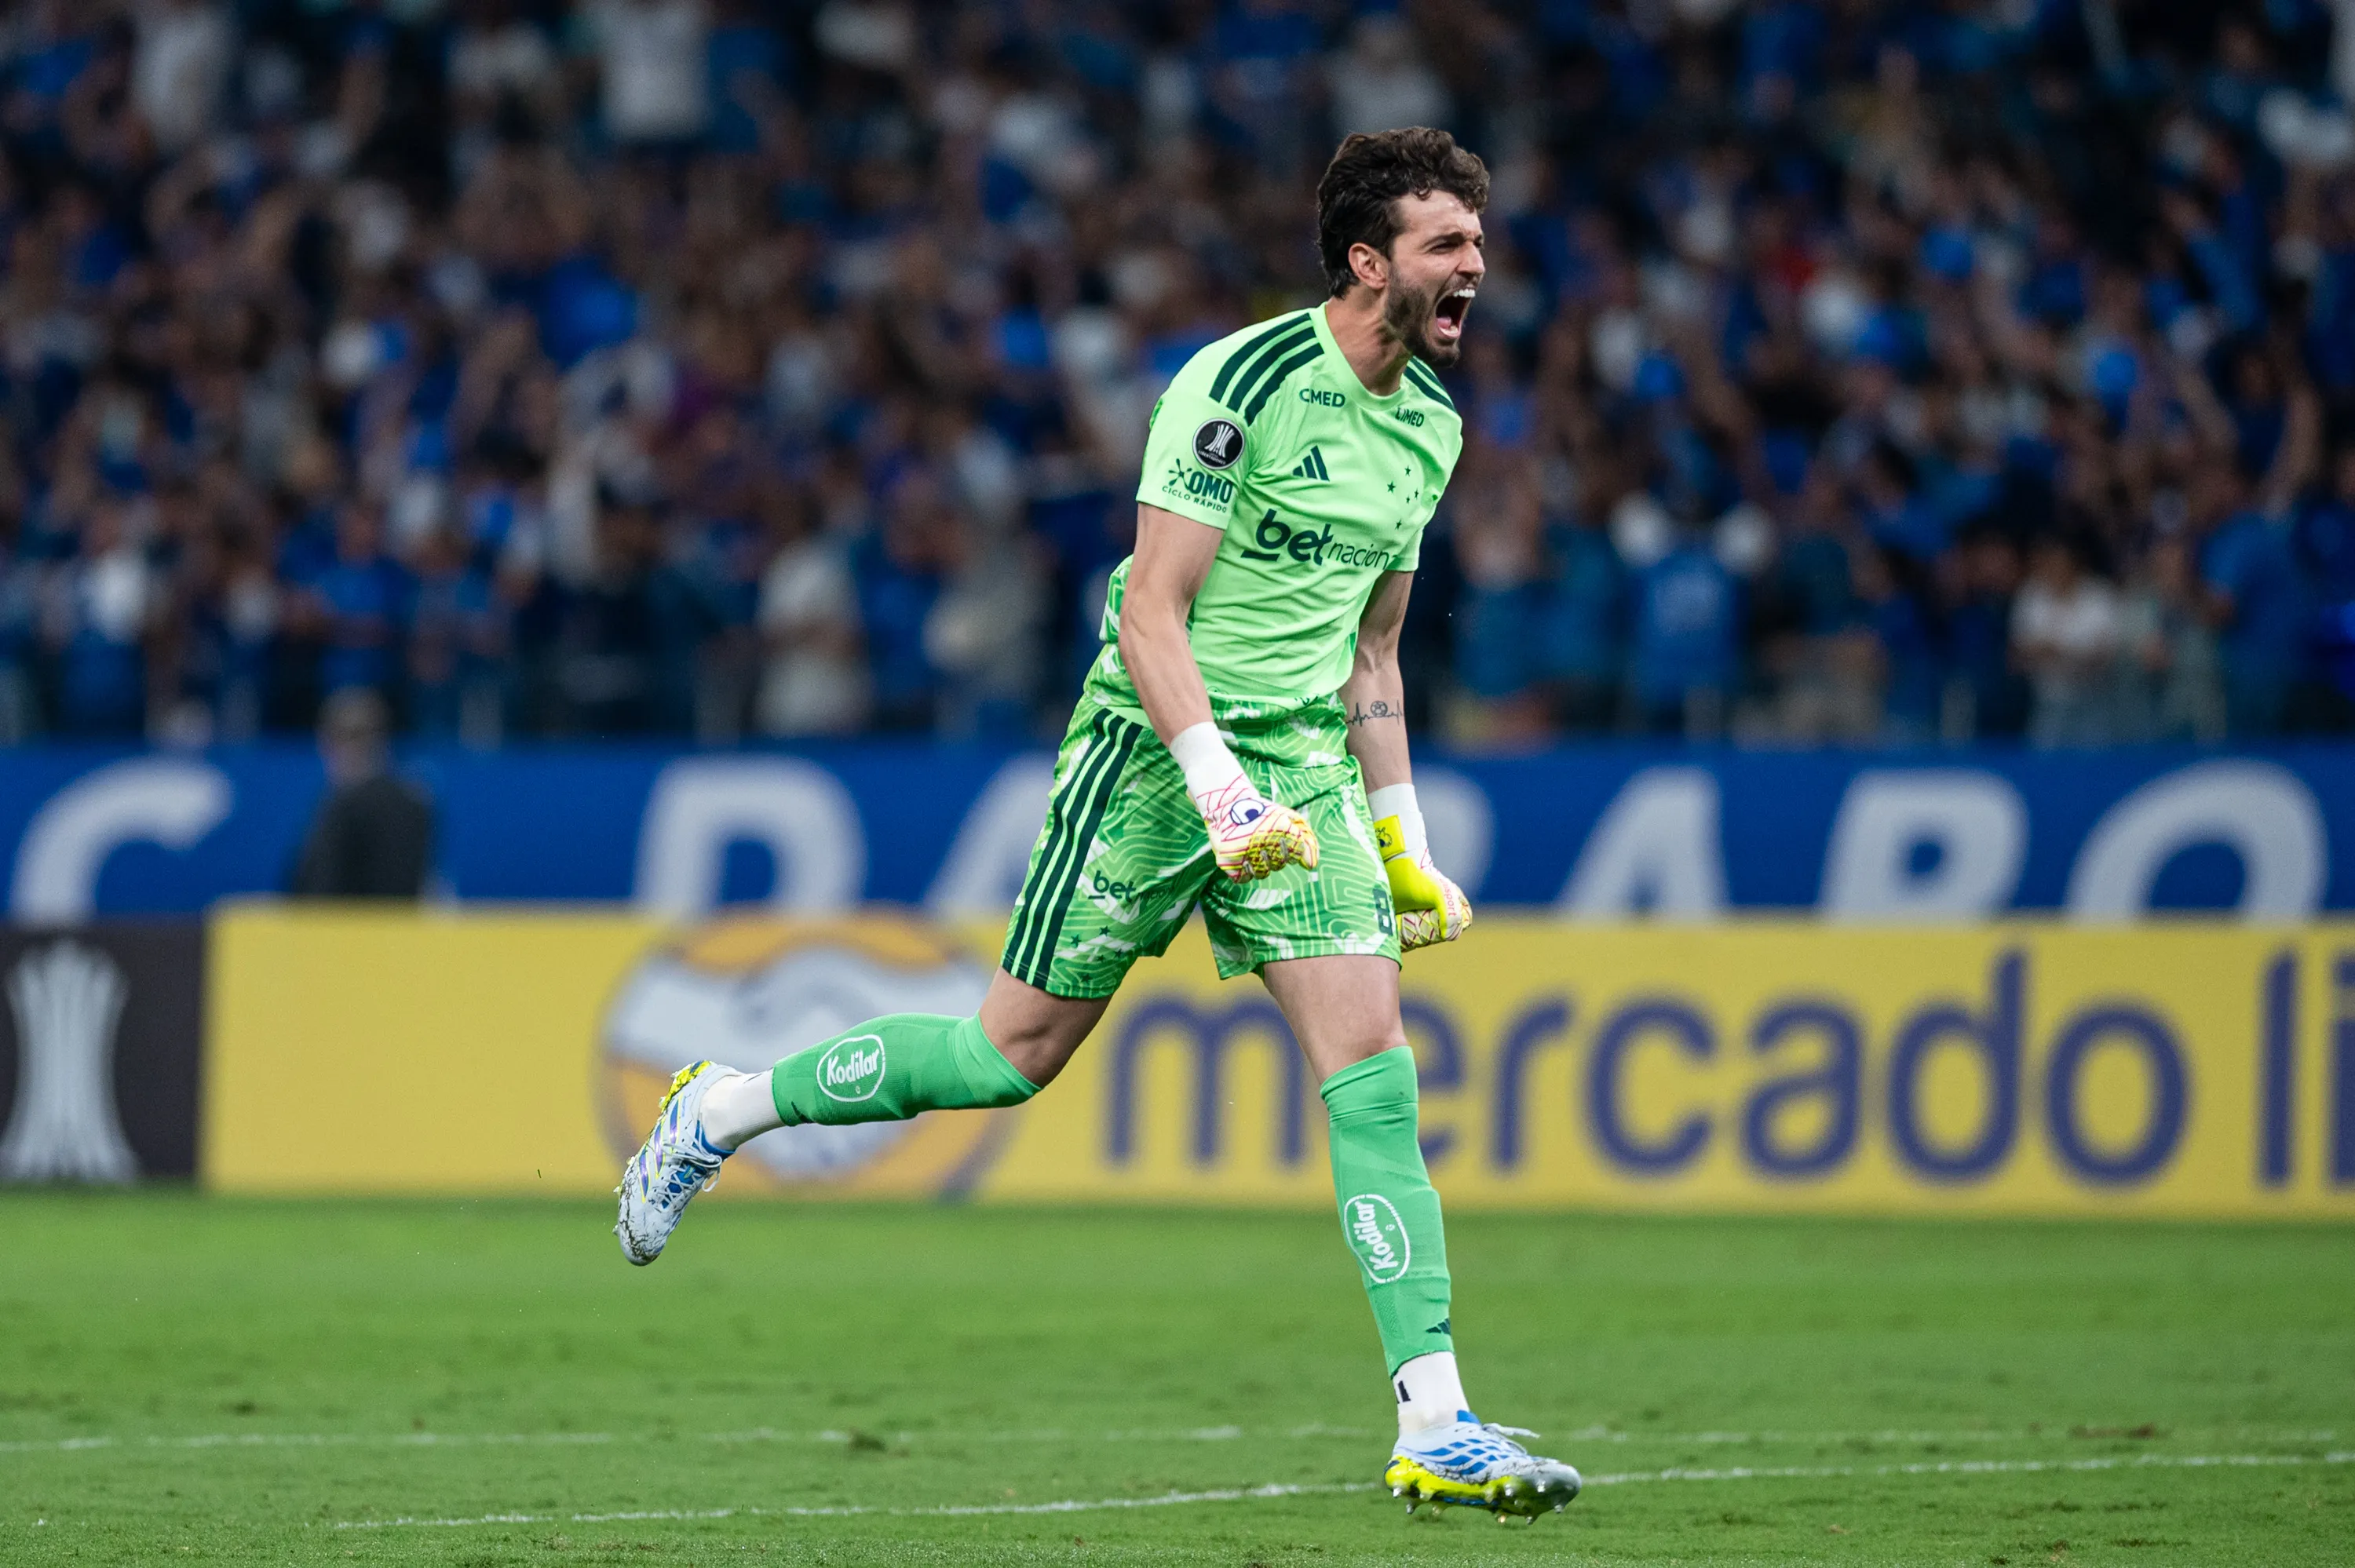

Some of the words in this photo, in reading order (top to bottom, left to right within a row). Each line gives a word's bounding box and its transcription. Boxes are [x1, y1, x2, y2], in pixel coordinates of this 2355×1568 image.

[1299, 388, 1345, 407] CMED
[1162, 486, 1191, 501] CICLO
[1188, 471, 1233, 504] OMO
[1256, 509, 1398, 570] betnacion
[827, 1048, 880, 1087] Kodilar
[1353, 1201, 1399, 1271] Kodilar
